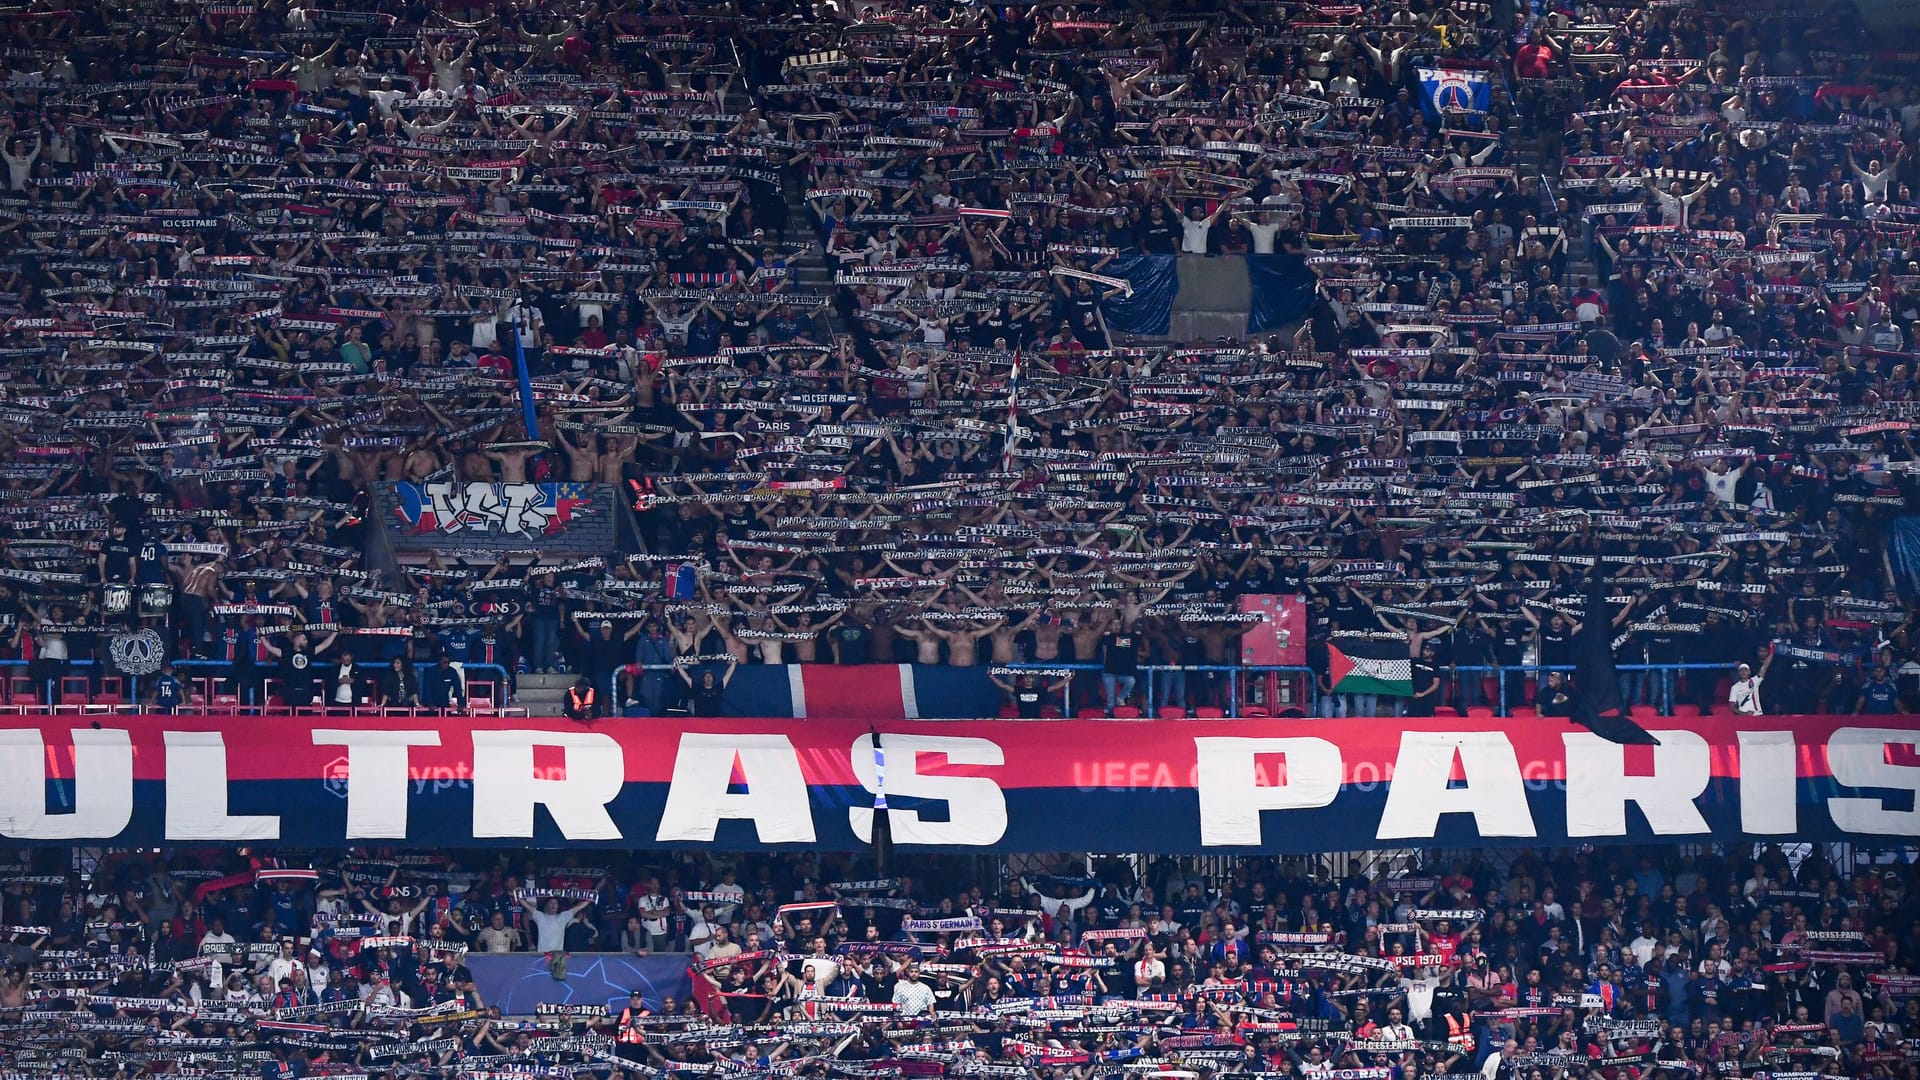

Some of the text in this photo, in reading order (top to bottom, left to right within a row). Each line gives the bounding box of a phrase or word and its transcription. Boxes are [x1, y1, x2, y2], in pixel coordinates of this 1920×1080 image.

[758, 422, 790, 431] PARIS
[1517, 553, 1552, 562] IRAGE
[1697, 580, 1767, 594] MM XIII
[1074, 762, 1177, 793] UEFA
[0, 727, 1920, 846] ULTRAS PARIS
[362, 937, 410, 948] ARIS
[1419, 954, 1442, 965] 1970
[786, 1024, 812, 1035] ARIS
